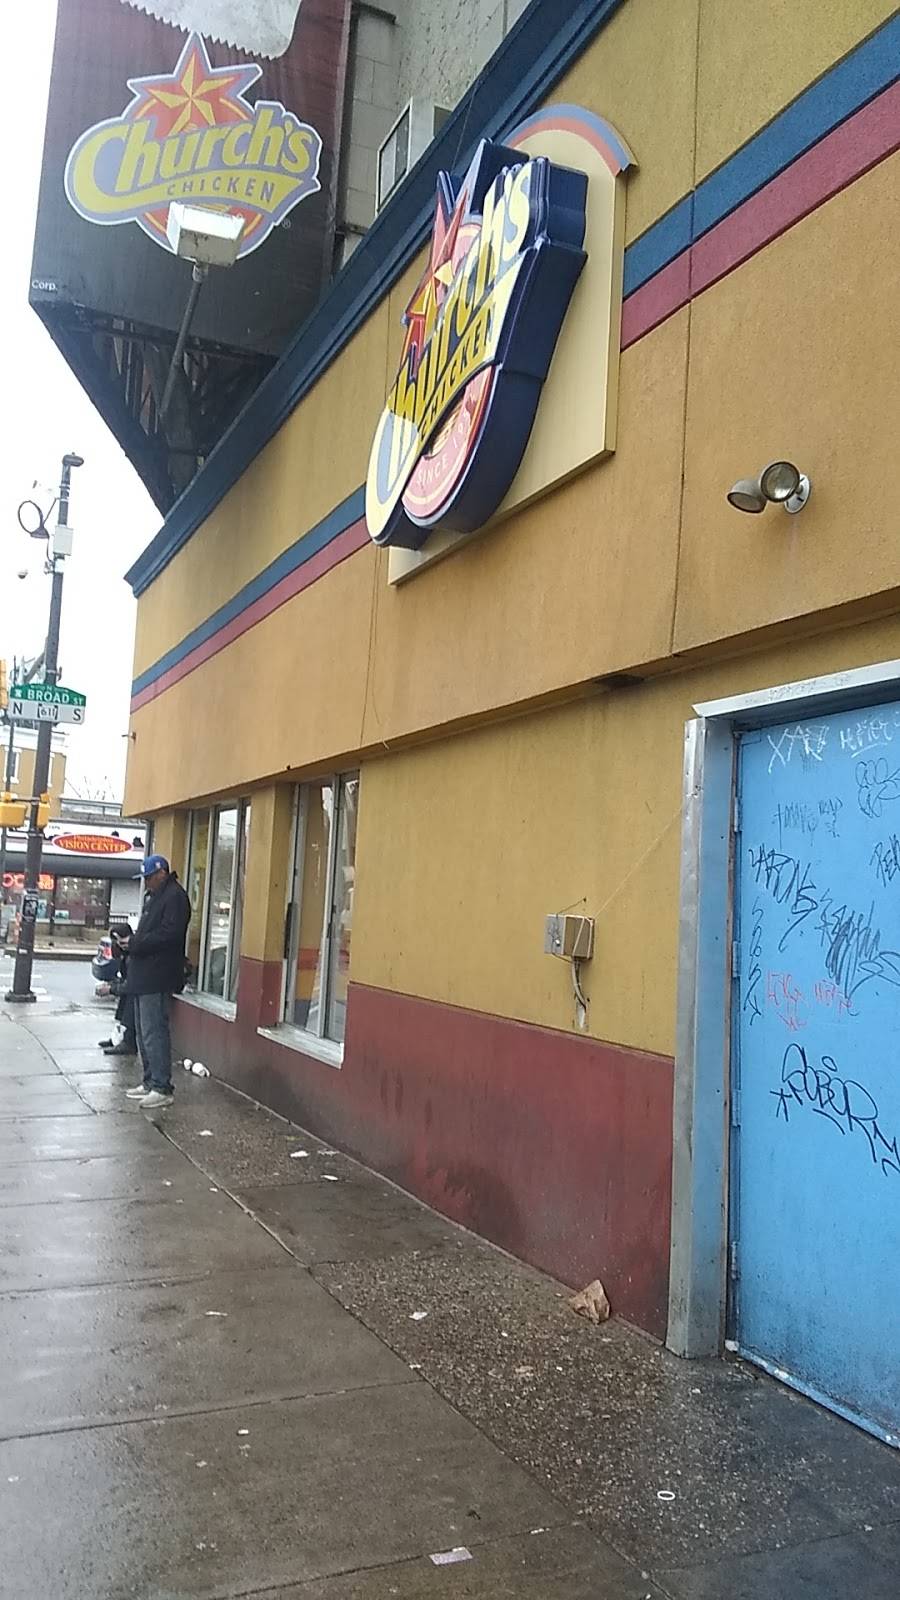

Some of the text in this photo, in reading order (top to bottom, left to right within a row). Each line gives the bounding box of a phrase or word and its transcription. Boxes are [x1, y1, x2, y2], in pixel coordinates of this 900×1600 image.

[73, 109, 313, 213] Church's
[167, 177, 276, 204] CHICKEN
[31, 280, 58, 291] Corp.
[420, 304, 495, 441] CHICKEN
[417, 455, 449, 485] SINCE
[28, 689, 70, 703] BROAD
[13, 702, 82, 721] N 611 S
[58, 840, 126, 852] VISION CENTER
